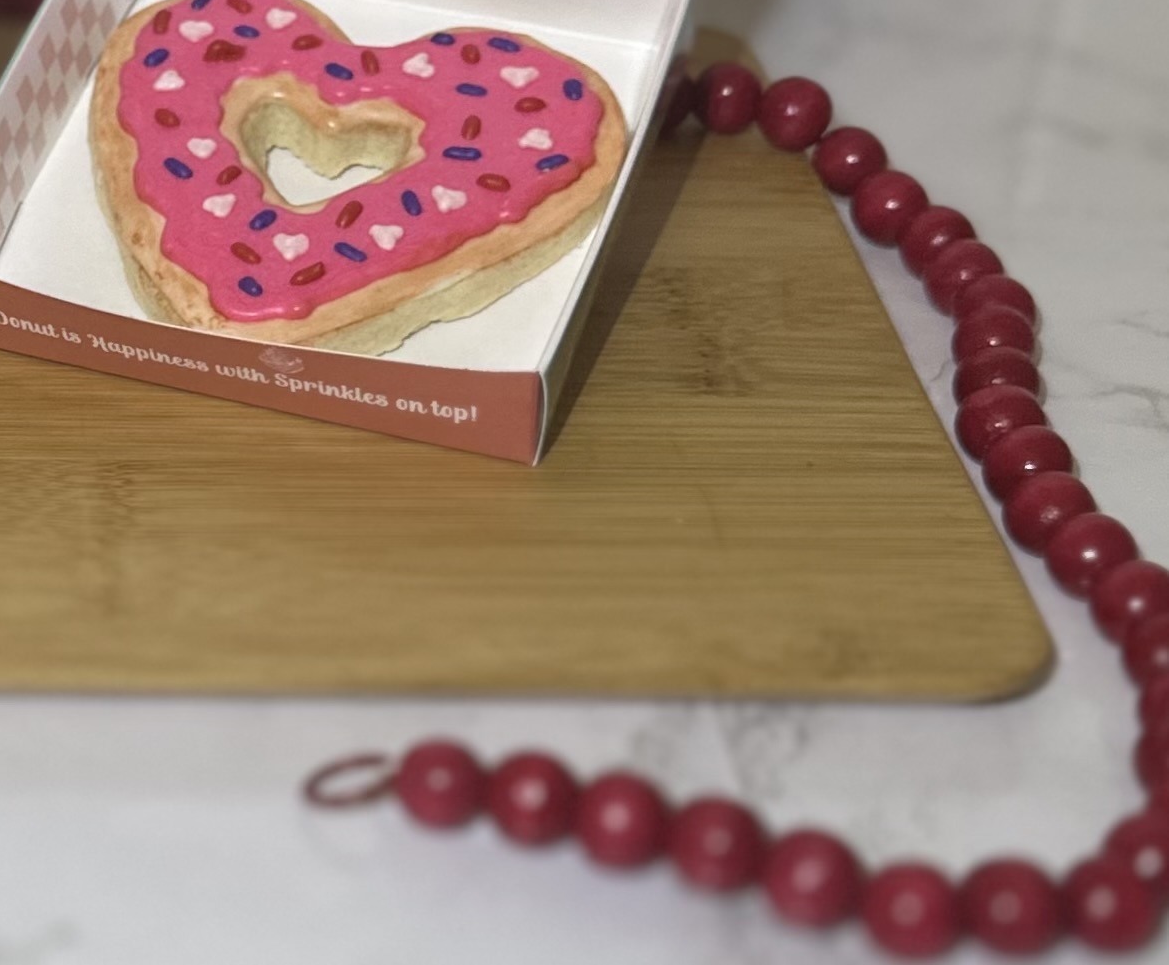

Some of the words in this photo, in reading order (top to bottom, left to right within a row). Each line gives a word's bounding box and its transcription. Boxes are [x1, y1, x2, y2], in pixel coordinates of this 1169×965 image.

[61, 326, 82, 344] is
[86, 332, 210, 372] Happiness
[215, 363, 271, 385] with
[274, 371, 390, 408] Sprinkles
[395, 397, 428, 415] on
[430, 399, 479, 424] top!
